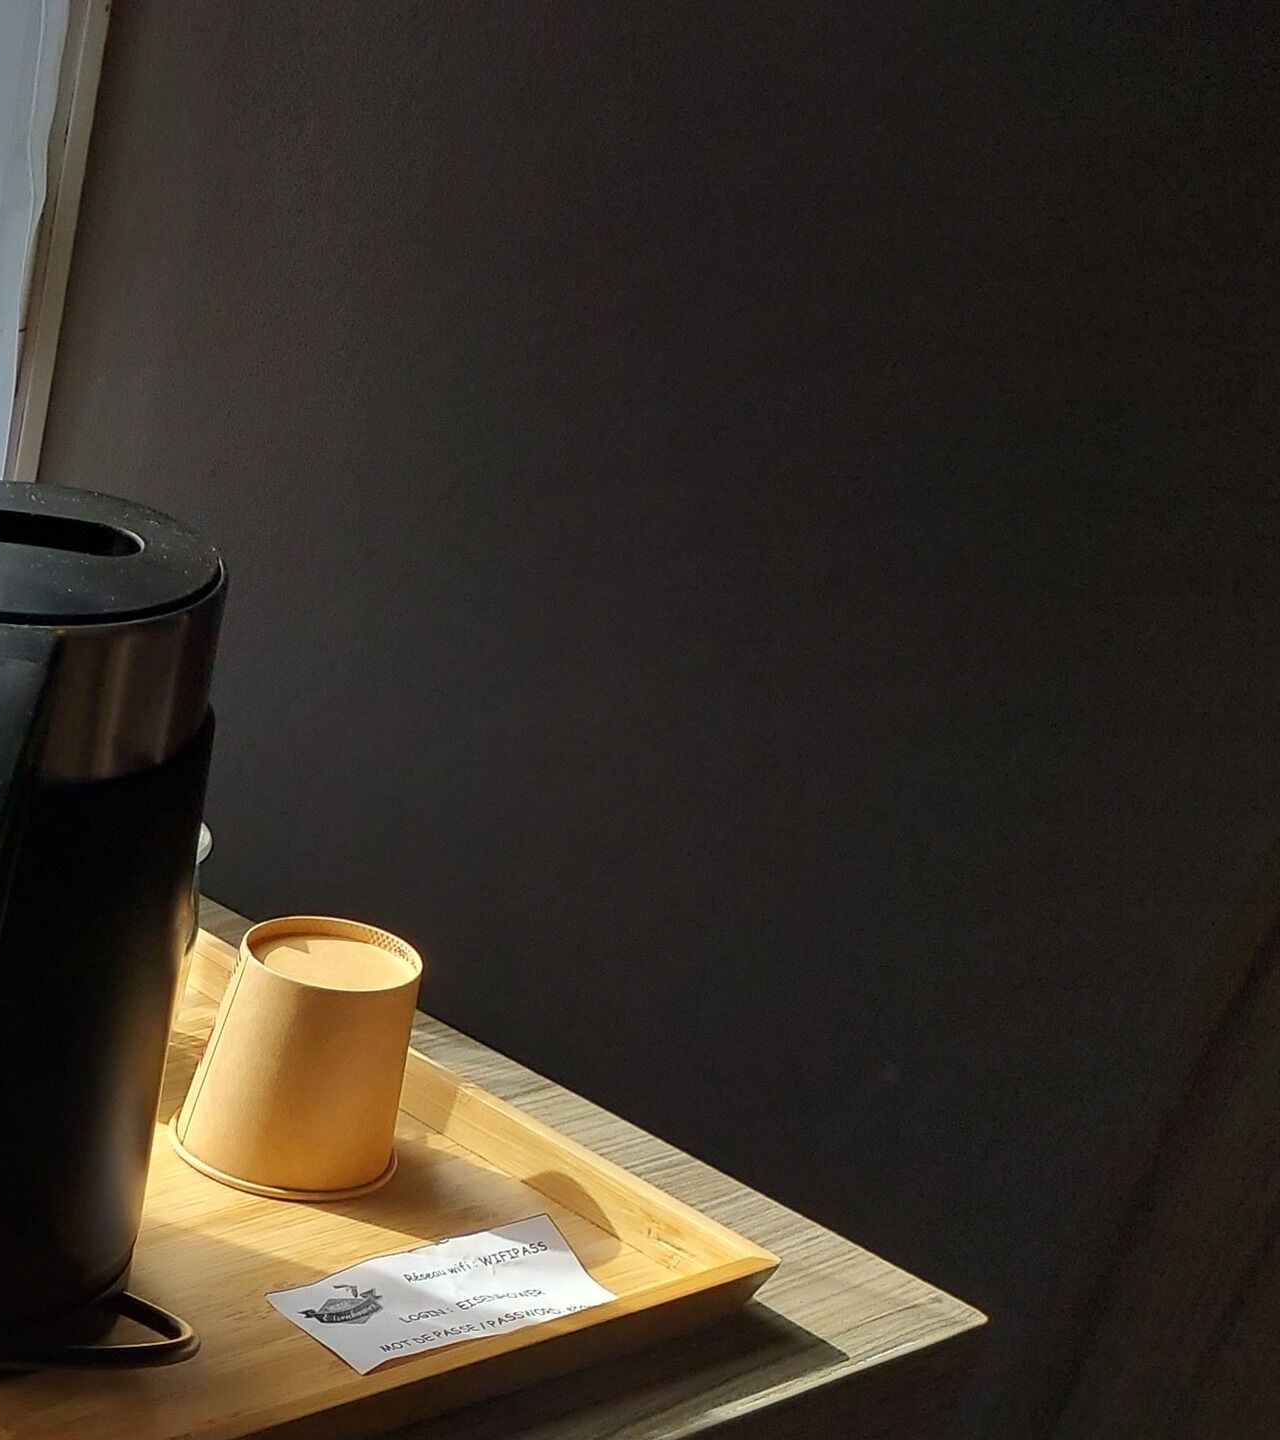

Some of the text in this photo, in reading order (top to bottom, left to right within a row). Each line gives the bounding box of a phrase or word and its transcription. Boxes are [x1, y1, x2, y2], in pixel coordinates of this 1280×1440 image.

[447, 1260, 472, 1275] wifi
[478, 1241, 549, 1267] WIFIPASS
[399, 1307, 447, 1324] LOGIN
[380, 1339, 412, 1353] MOT
[413, 1333, 432, 1345] DE
[433, 1323, 479, 1340] PASSE
